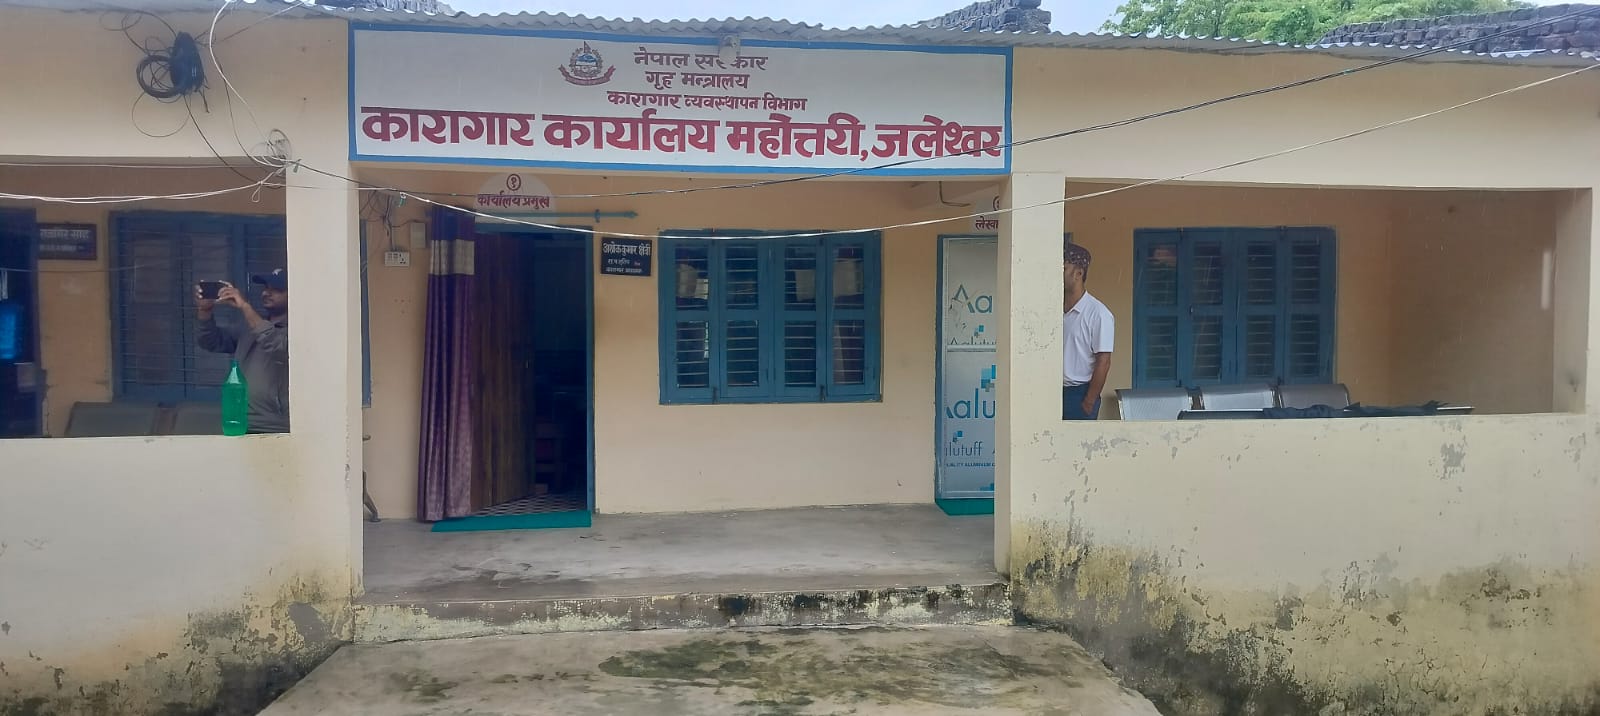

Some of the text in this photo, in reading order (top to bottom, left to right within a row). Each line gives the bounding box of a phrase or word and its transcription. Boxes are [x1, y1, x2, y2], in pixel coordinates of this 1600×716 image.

[634, 47, 689, 68] नेपाल
[646, 71, 749, 89] गृह मन्त्रालय
[607, 91, 807, 111] कारागार व्यवस्थापन विभाग
[361, 107, 535, 147] कारागार
[542, 108, 720, 153] कार्यालय
[477, 190, 550, 209] कार्यालय प्रमुख
[945, 441, 983, 457] lutuff
